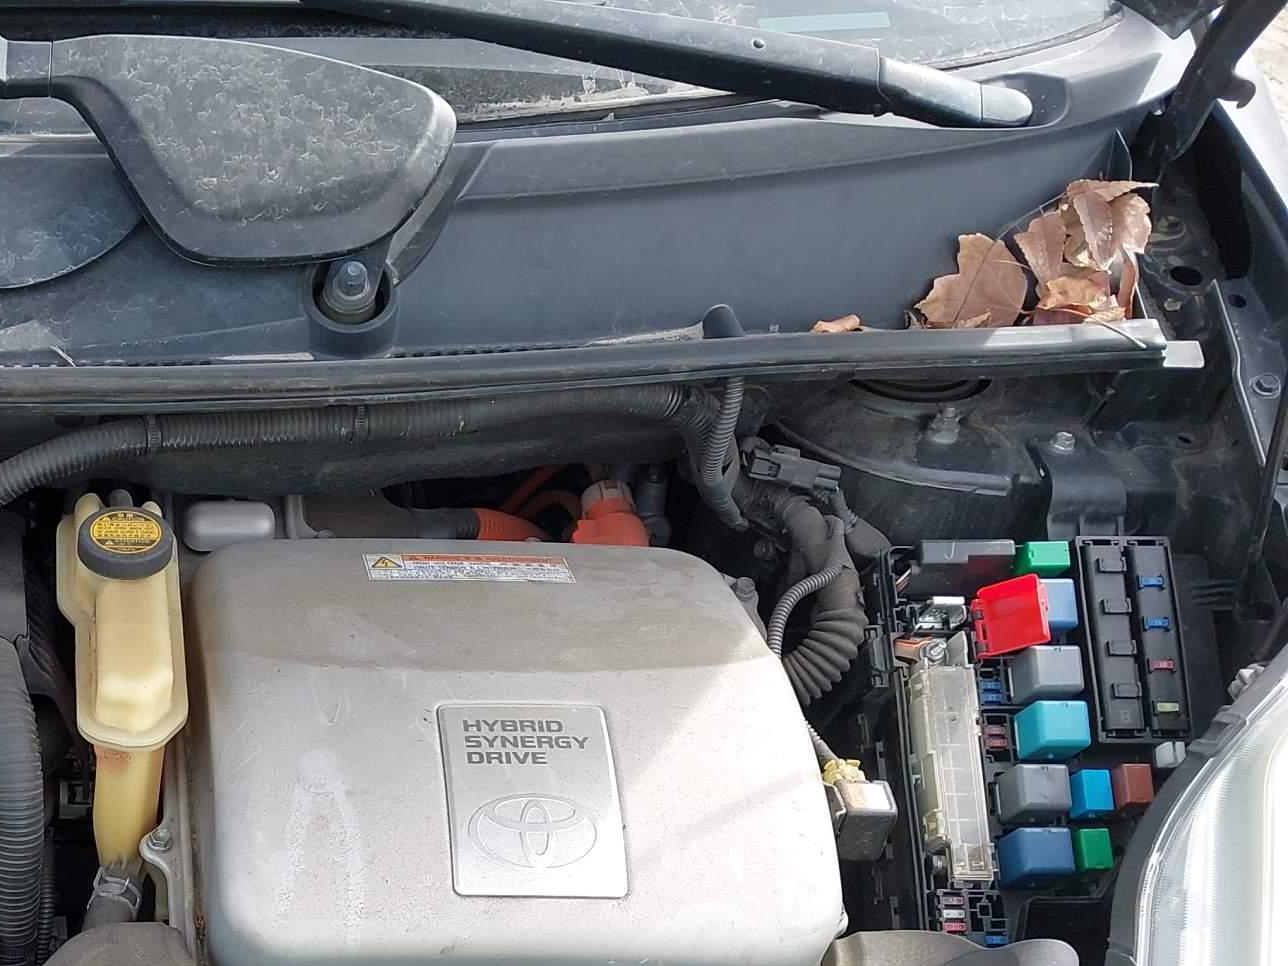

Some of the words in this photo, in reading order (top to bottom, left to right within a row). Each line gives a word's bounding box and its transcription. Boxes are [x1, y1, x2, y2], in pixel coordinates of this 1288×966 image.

[463, 719, 563, 733] HYBRID
[465, 735, 589, 749] SYNERGY
[467, 751, 548, 765] DRIVE
